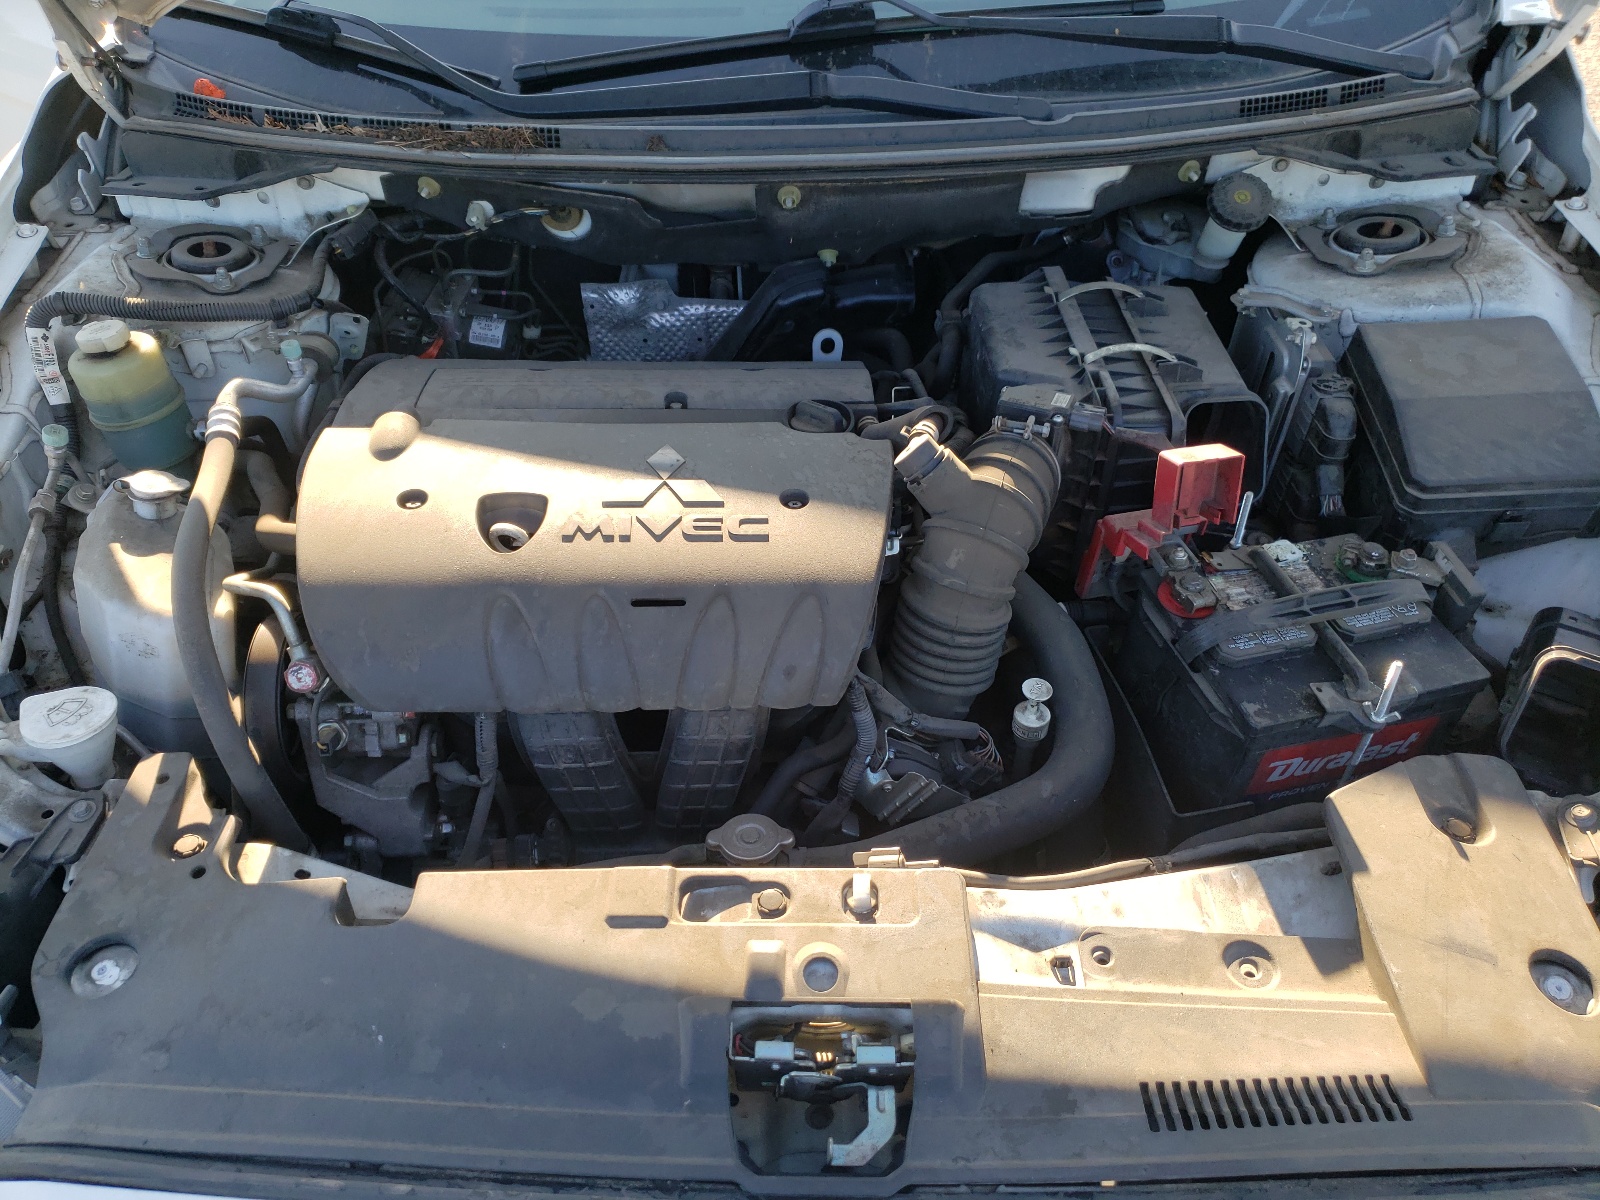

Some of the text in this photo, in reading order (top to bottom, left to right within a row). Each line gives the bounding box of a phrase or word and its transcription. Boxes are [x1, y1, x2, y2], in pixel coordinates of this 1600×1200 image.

[559, 514, 770, 543] MIVEC
[1266, 731, 1421, 783] Duraast
[1269, 782, 1329, 800] PROVEN
